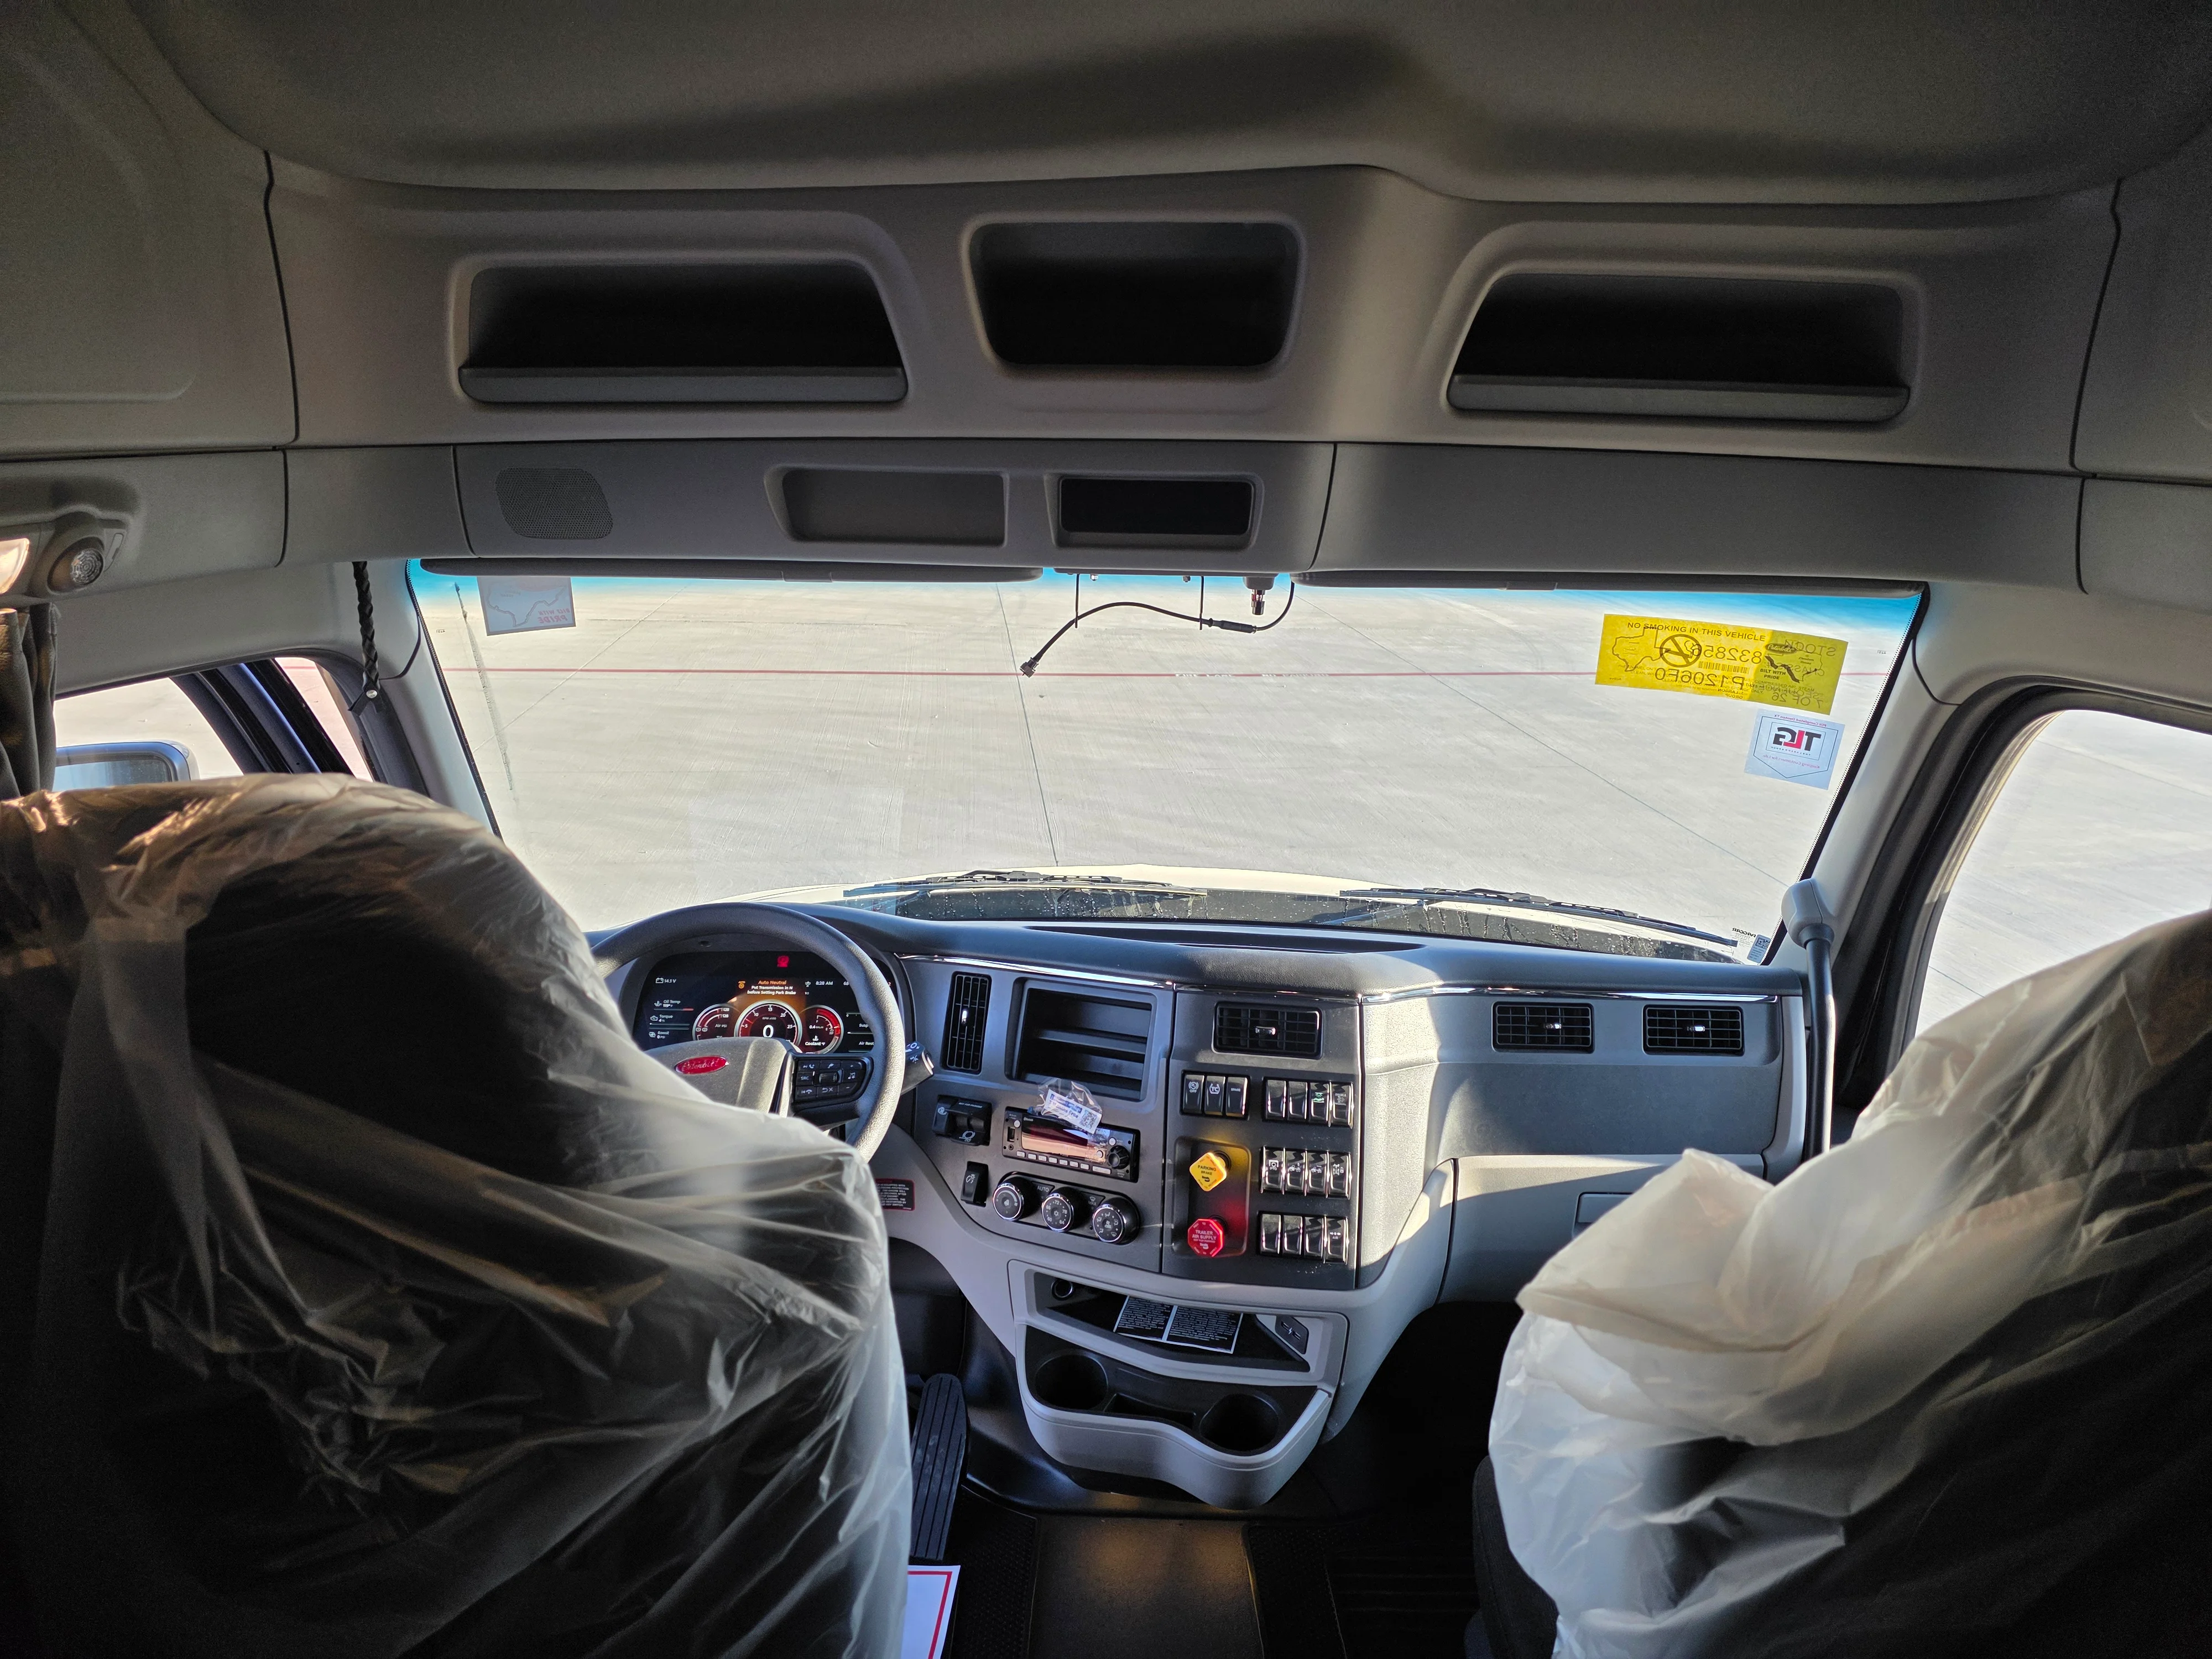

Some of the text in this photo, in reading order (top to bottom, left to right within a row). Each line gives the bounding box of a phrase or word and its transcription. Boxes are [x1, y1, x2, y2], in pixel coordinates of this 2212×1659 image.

[1644, 623, 1687, 633] SMOKING
[1702, 628, 1722, 637] THIS
[1725, 631, 1766, 641] VEHICLE
[763, 1025, 774, 1038] 0
